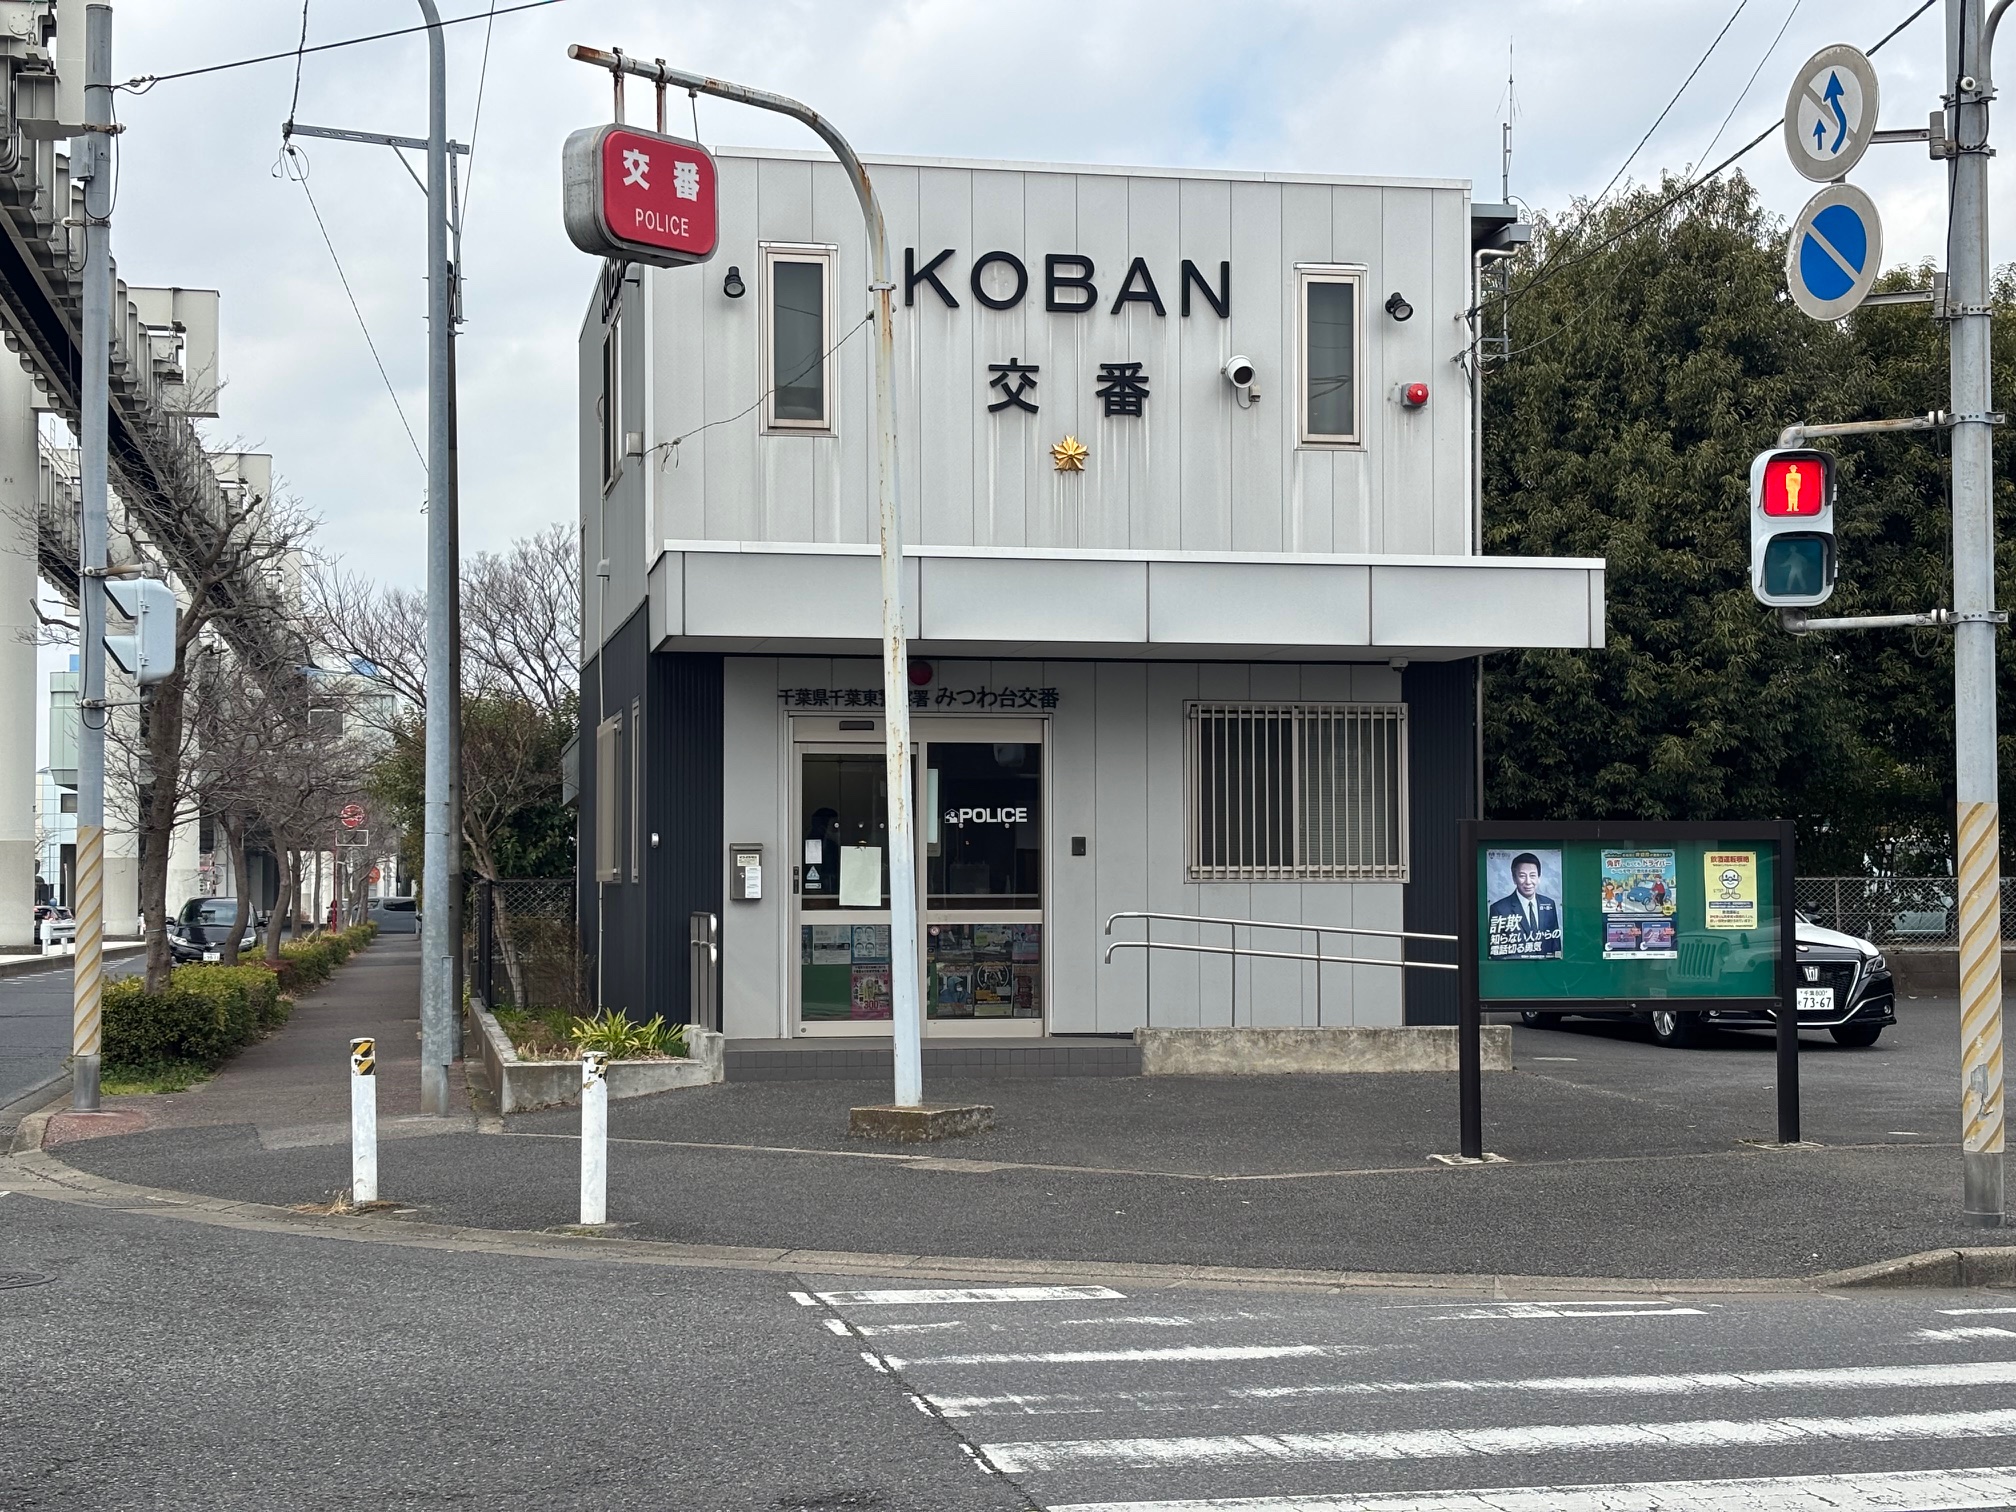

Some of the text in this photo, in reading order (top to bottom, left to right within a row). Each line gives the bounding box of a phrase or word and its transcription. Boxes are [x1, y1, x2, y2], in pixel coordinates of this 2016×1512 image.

[622, 148, 700, 202] 交番
[635, 208, 690, 237] POLICE
[904, 247, 1231, 319] KOBAN
[988, 357, 1151, 418] 交番
[778, 686, 1060, 709] 千葉県千葉東署 みつわ台交番
[959, 808, 1027, 823] POLICE
[1490, 914, 1522, 934] 詐欺
[1490, 929, 1562, 945] 知らない人からの
[1803, 997, 1831, 1008] 73-67
